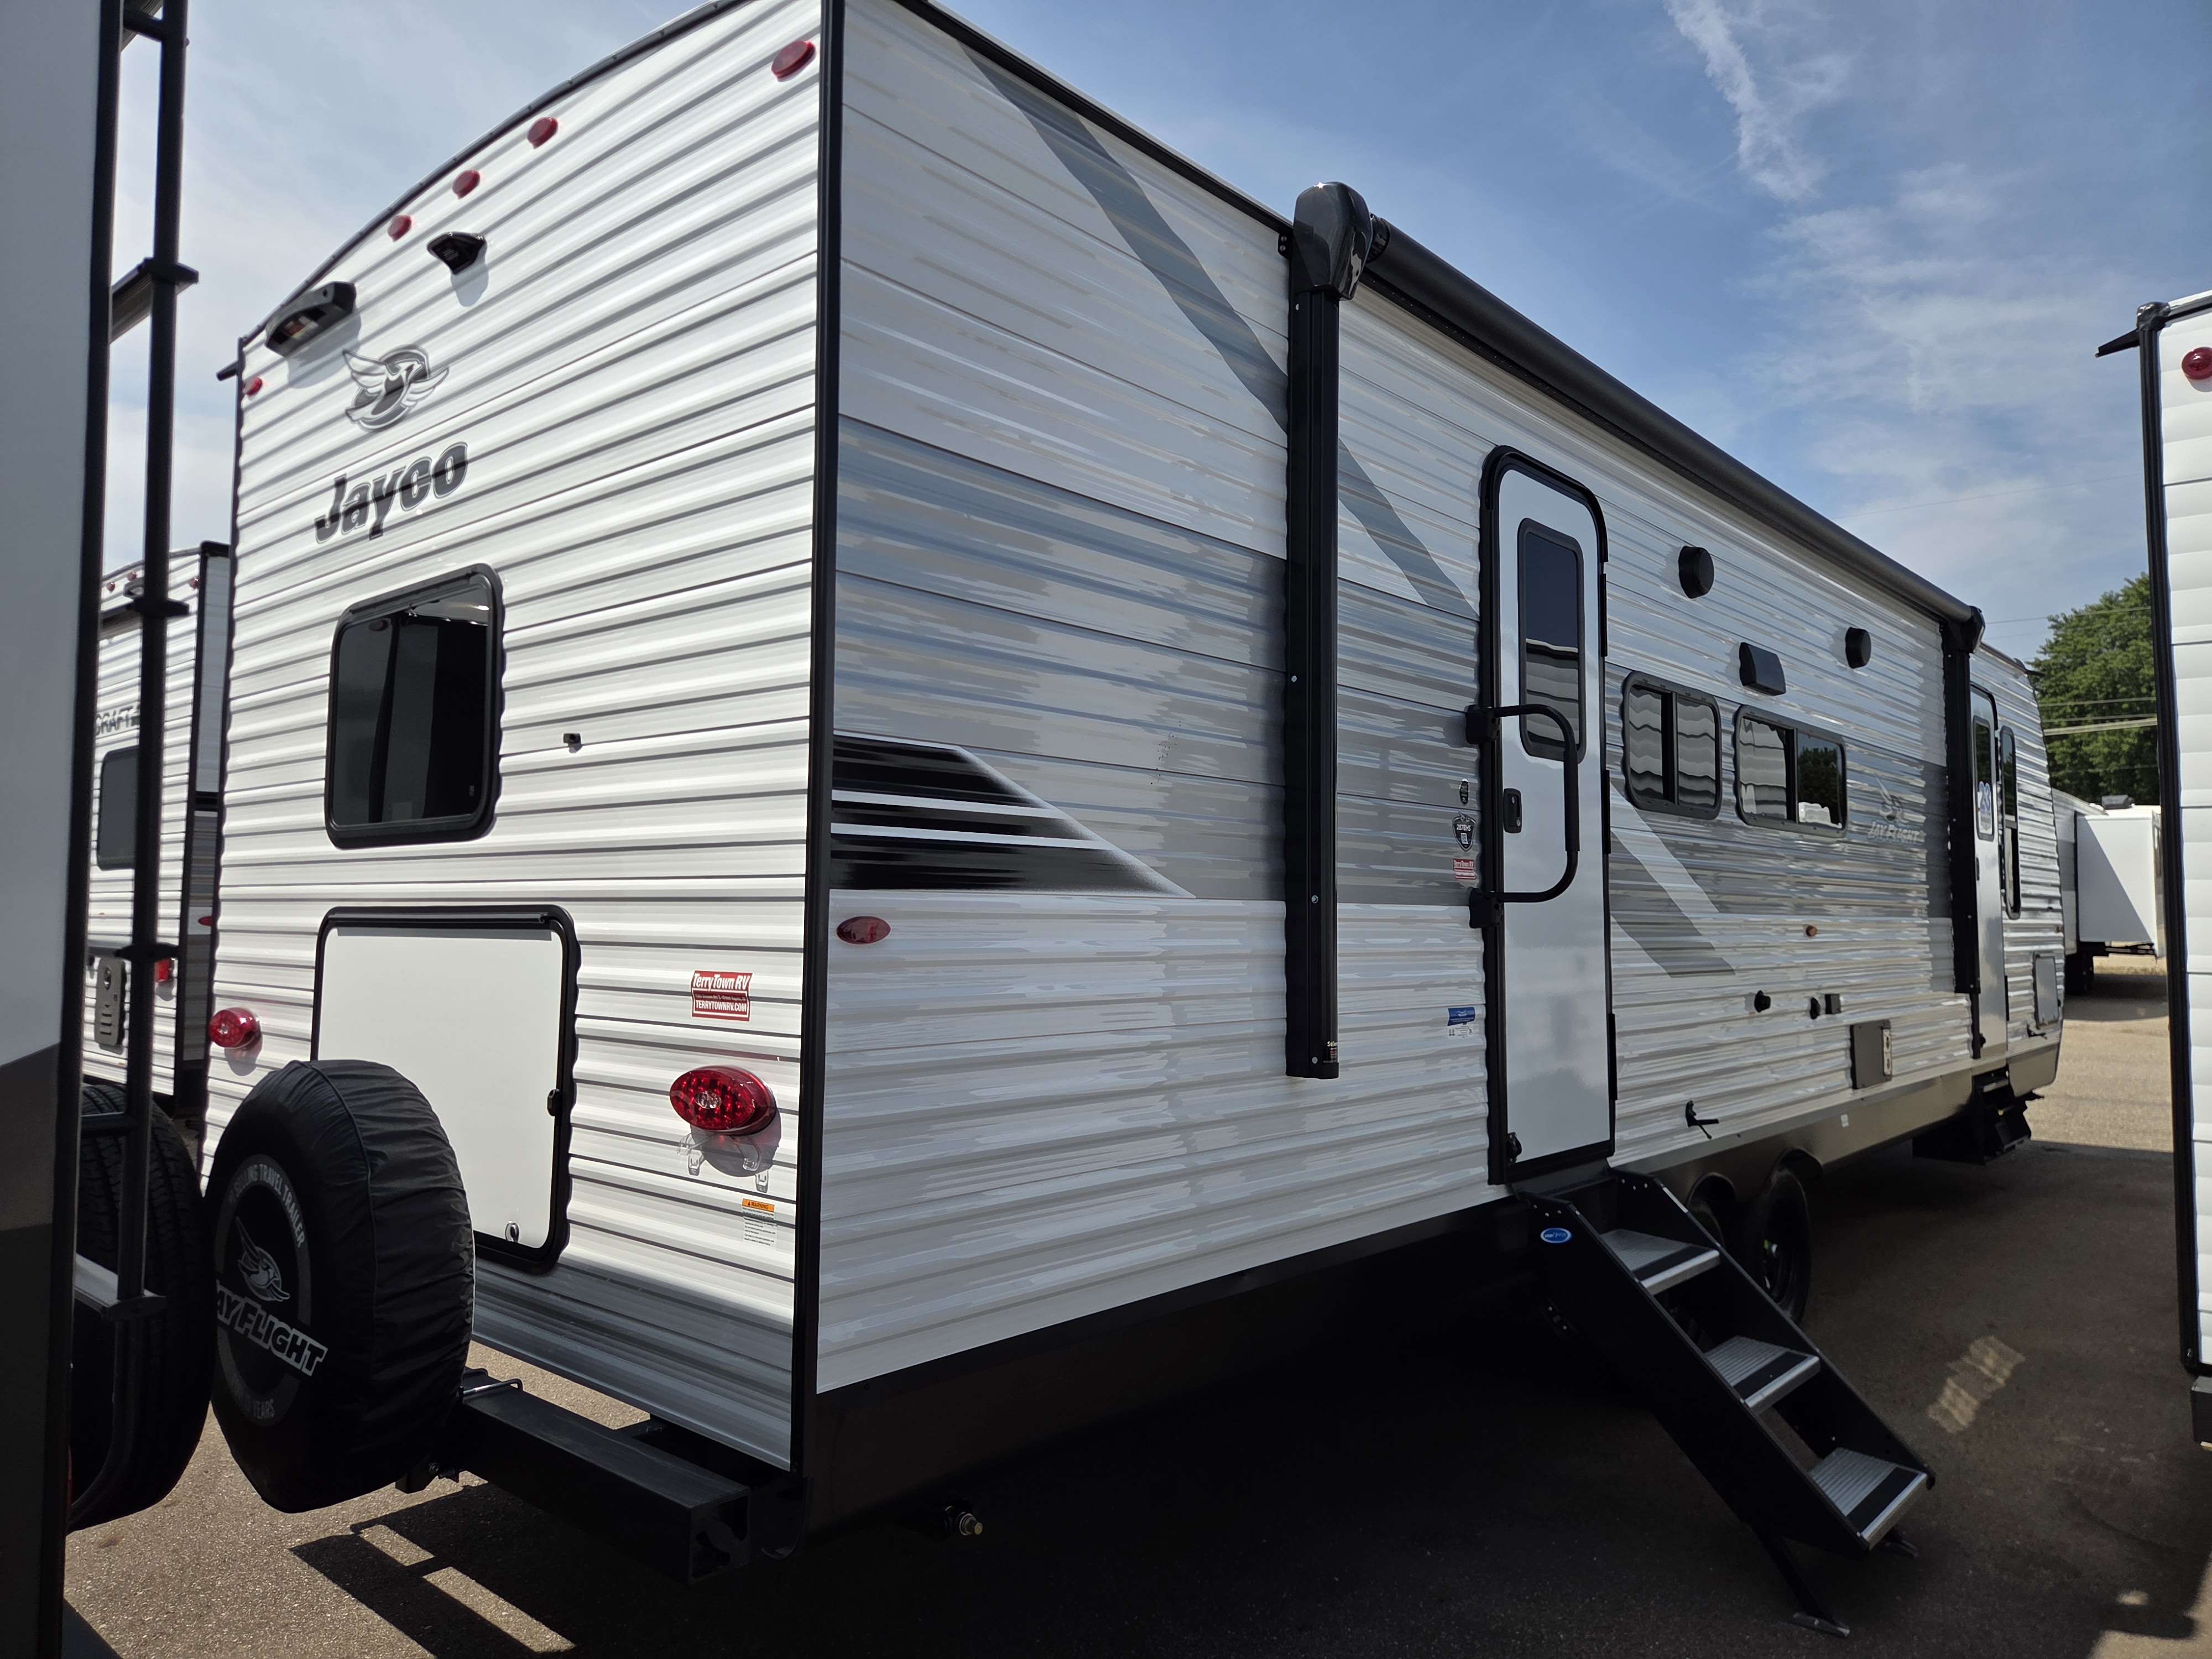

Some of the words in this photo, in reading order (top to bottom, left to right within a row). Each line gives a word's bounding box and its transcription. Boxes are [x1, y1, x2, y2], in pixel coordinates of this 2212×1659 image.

[314, 441, 469, 545] Jayco
[692, 973, 735, 992] TerryTown
[735, 975, 750, 990] RV
[696, 1000, 747, 1012] TERRYTOWNRV.COM
[281, 1184, 306, 1248] TRAILER
[751, 1201, 769, 1210] WARNING
[216, 1279, 328, 1376] AYFLIGHT
